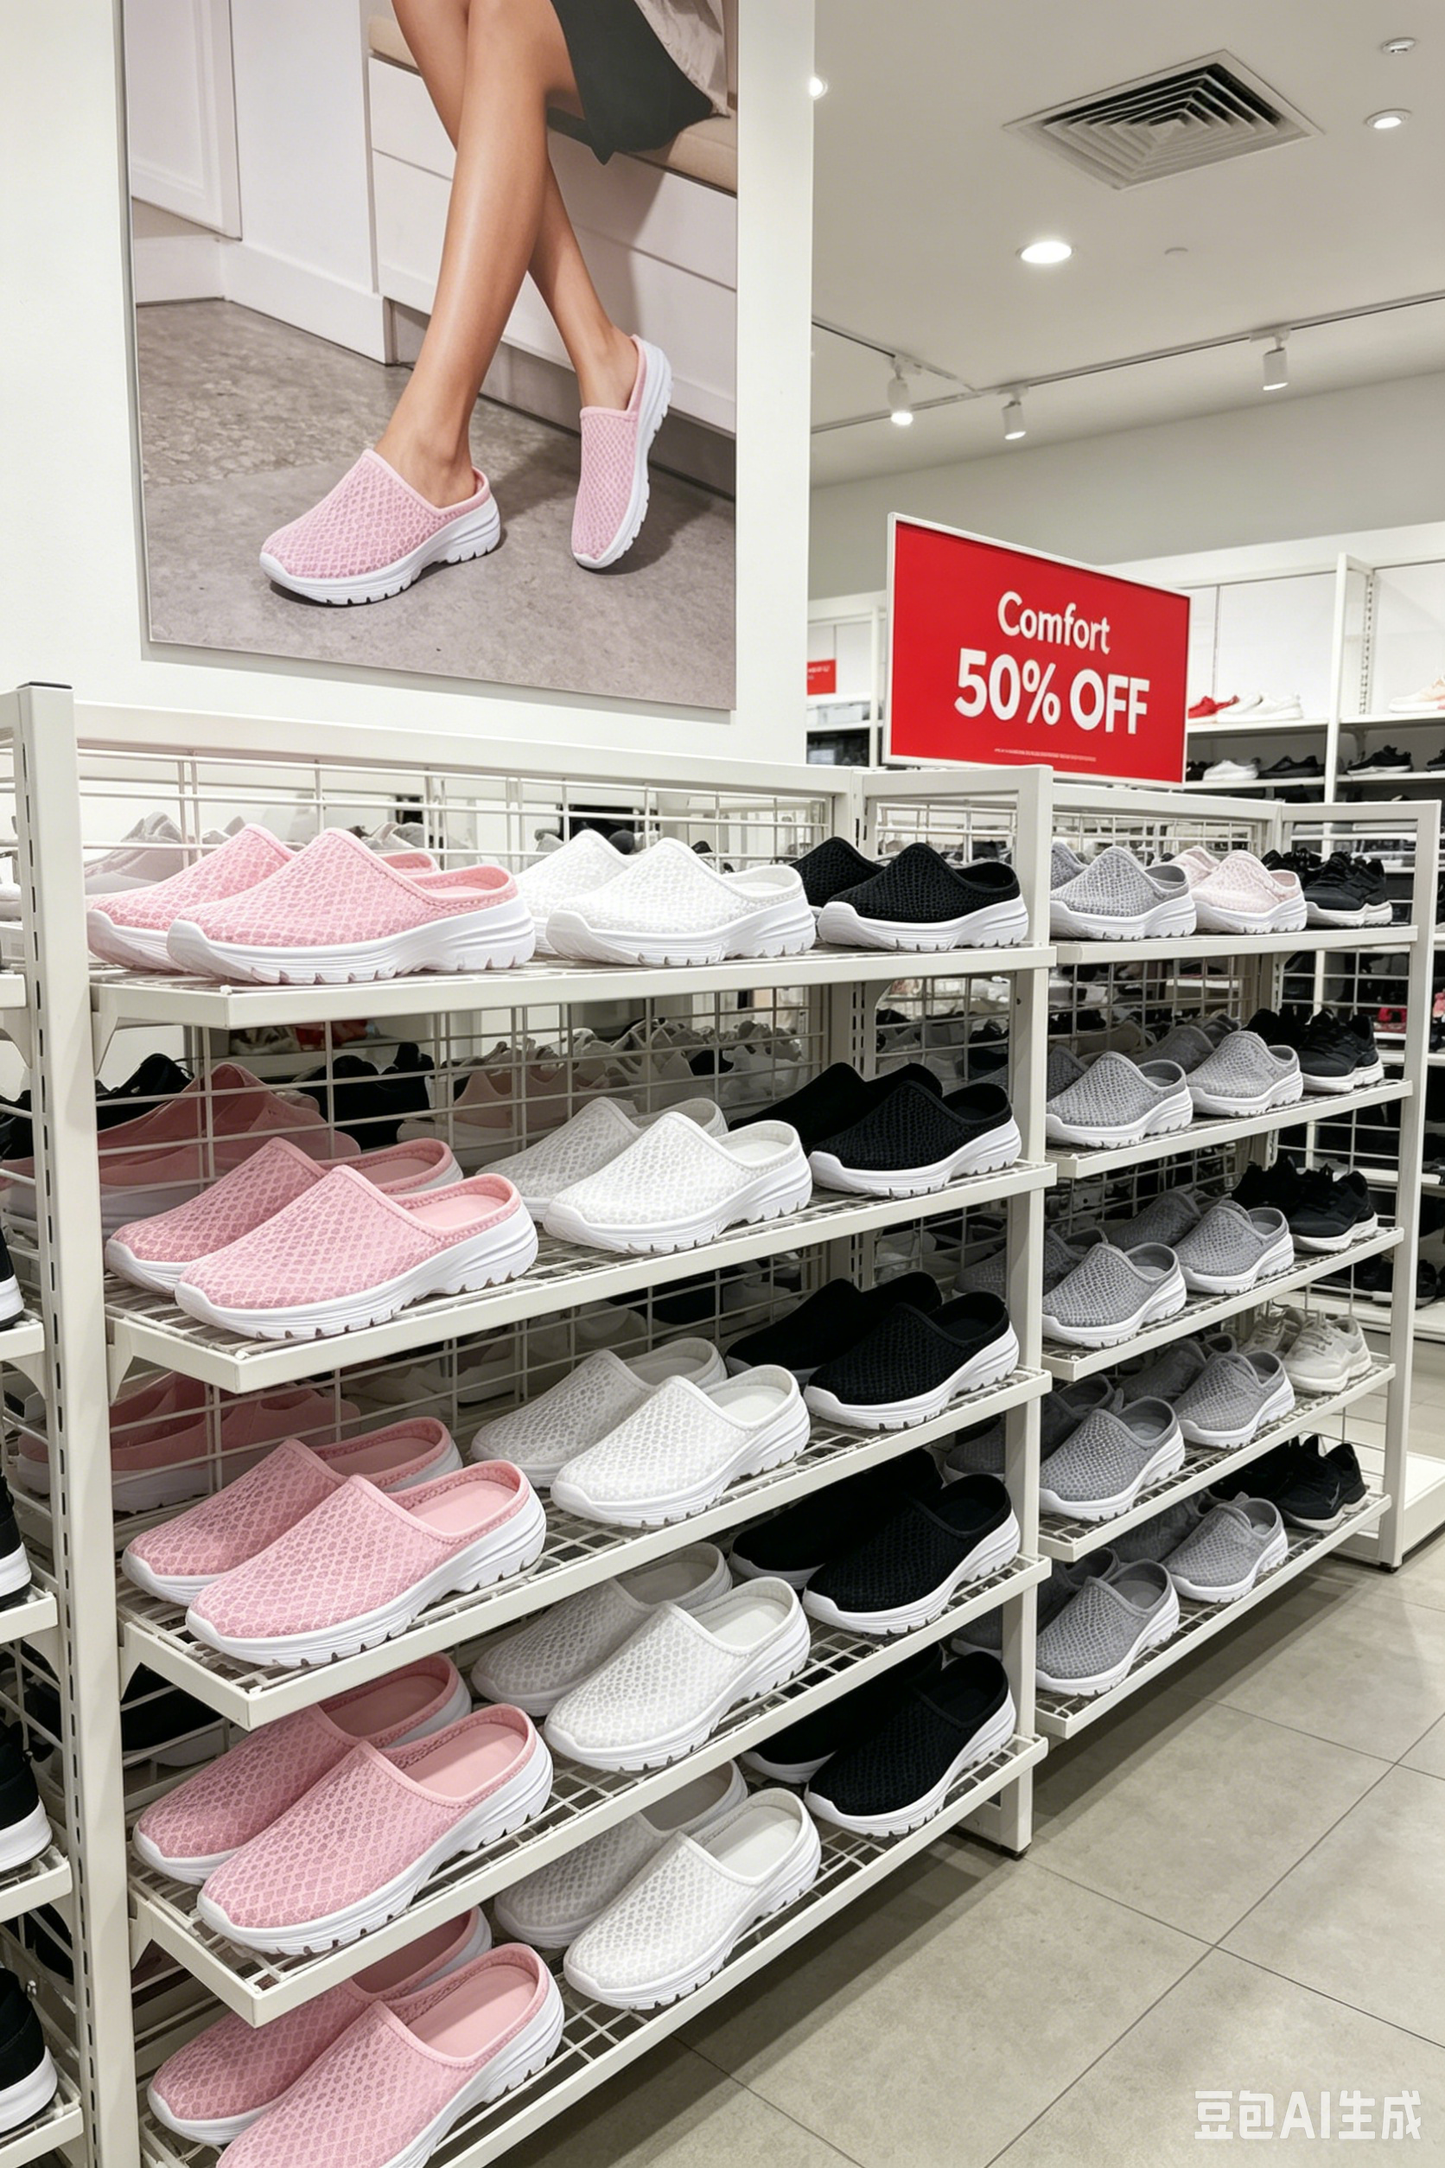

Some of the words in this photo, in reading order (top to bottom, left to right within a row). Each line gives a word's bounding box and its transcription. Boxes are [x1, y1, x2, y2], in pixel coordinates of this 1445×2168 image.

[997, 591, 1111, 655] Comfort
[954, 647, 1061, 726] 50%
[1069, 668, 1150, 735] OFF
